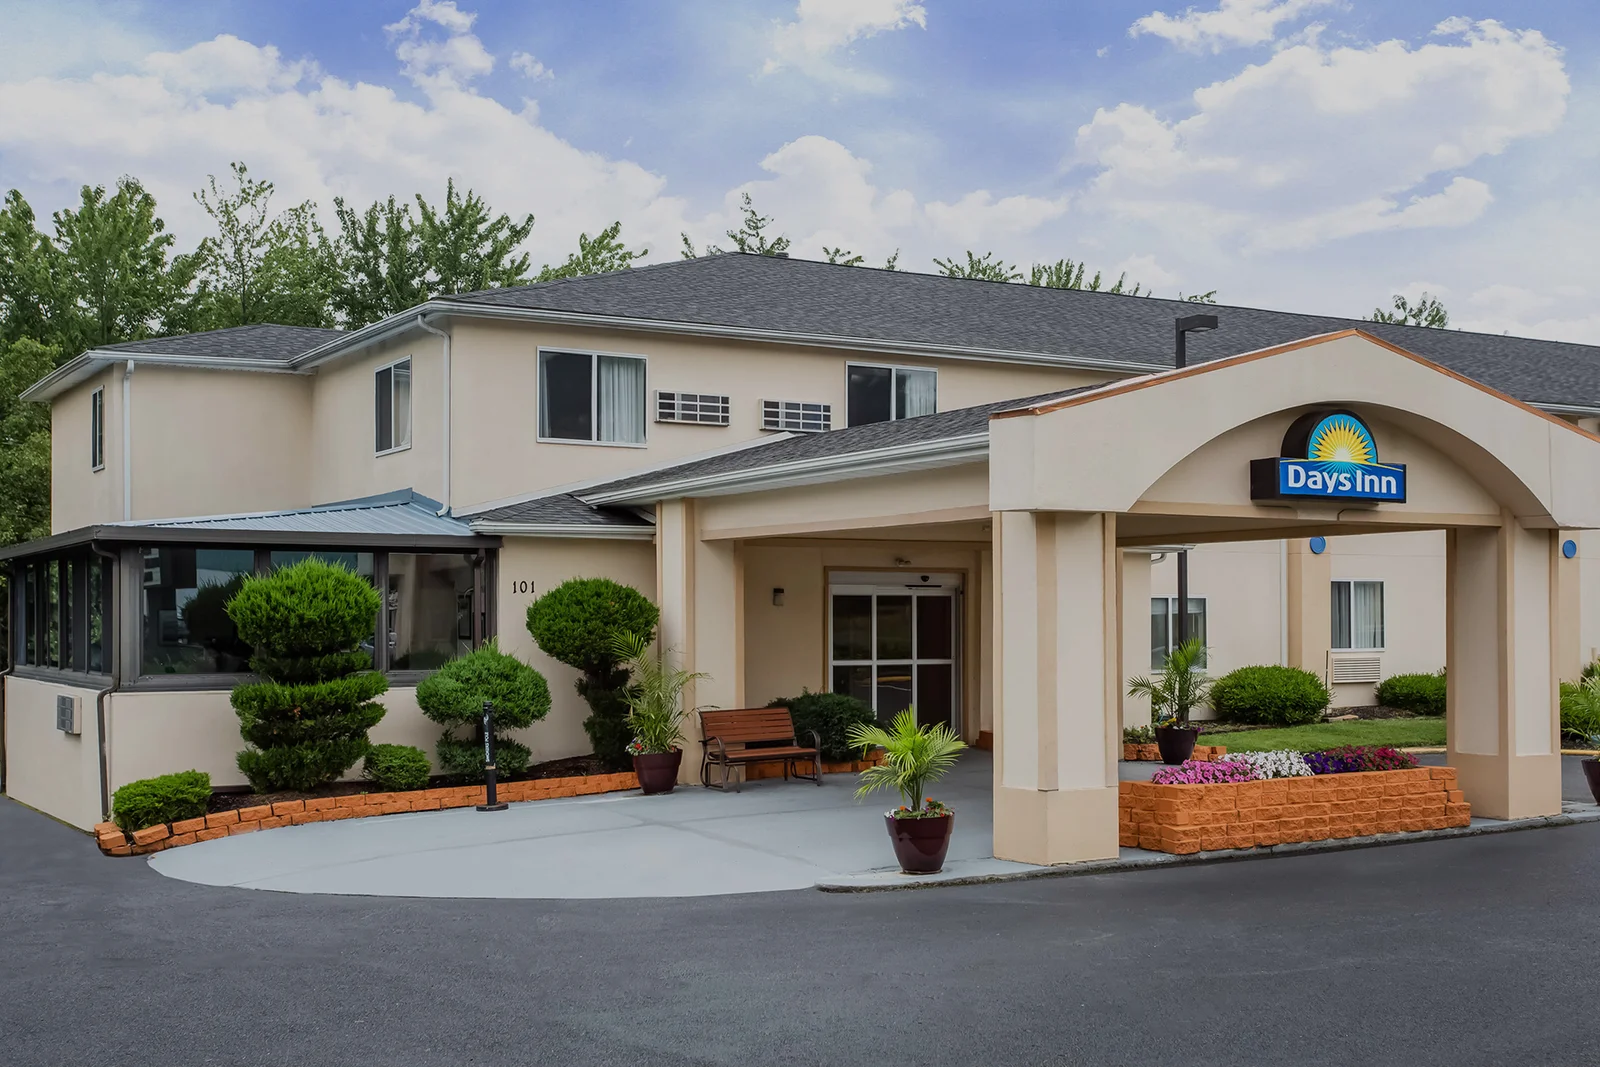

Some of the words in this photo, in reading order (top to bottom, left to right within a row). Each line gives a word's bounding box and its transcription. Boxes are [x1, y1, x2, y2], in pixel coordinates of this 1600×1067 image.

[1288, 465, 1352, 494] Days
[1356, 470, 1397, 494] Inn
[512, 580, 535, 594] 101
